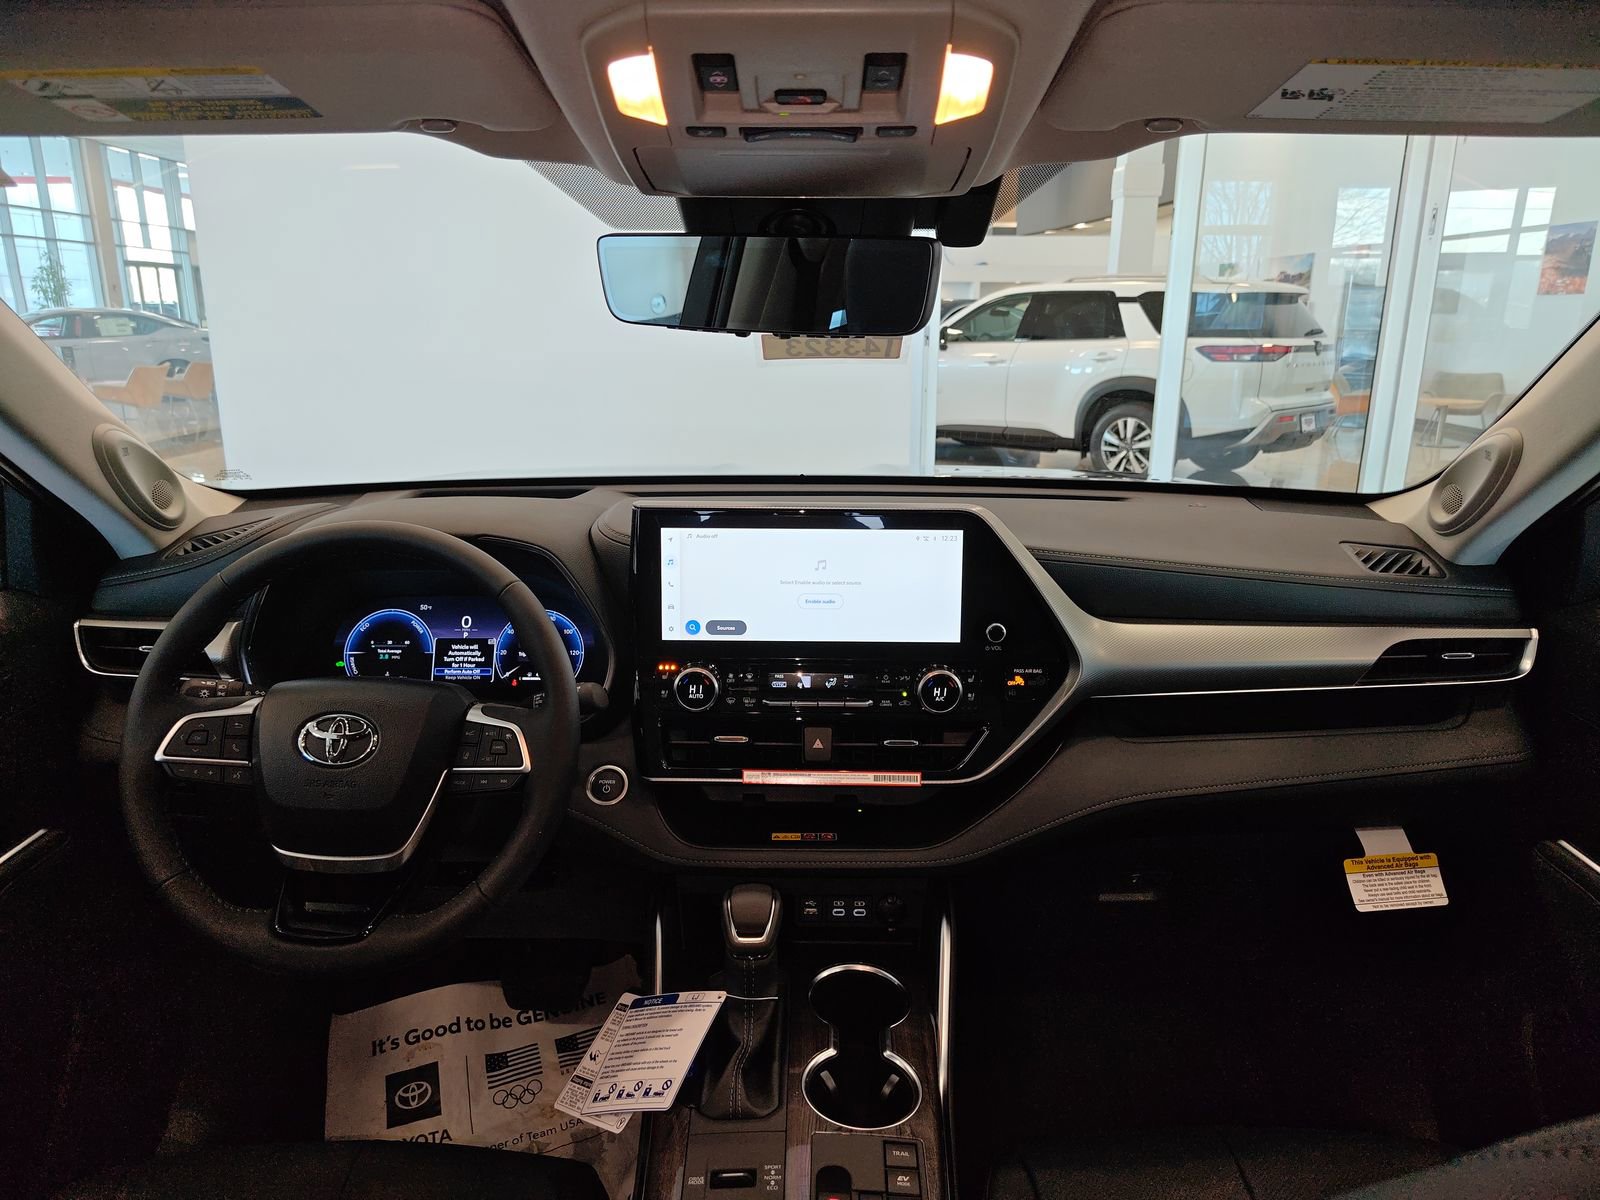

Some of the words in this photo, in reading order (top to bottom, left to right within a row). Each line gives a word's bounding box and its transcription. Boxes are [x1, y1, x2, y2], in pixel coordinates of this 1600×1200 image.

[461, 616, 472, 628] 0
[1392, 855, 1418, 863] Equipped
[370, 1035, 400, 1057] It's
[404, 1016, 461, 1046] Good
[465, 1016, 486, 1032] to
[489, 1013, 513, 1030] be
[513, 1134, 523, 1145] of
[526, 1127, 557, 1142] Team
[559, 1117, 584, 1131] USA
